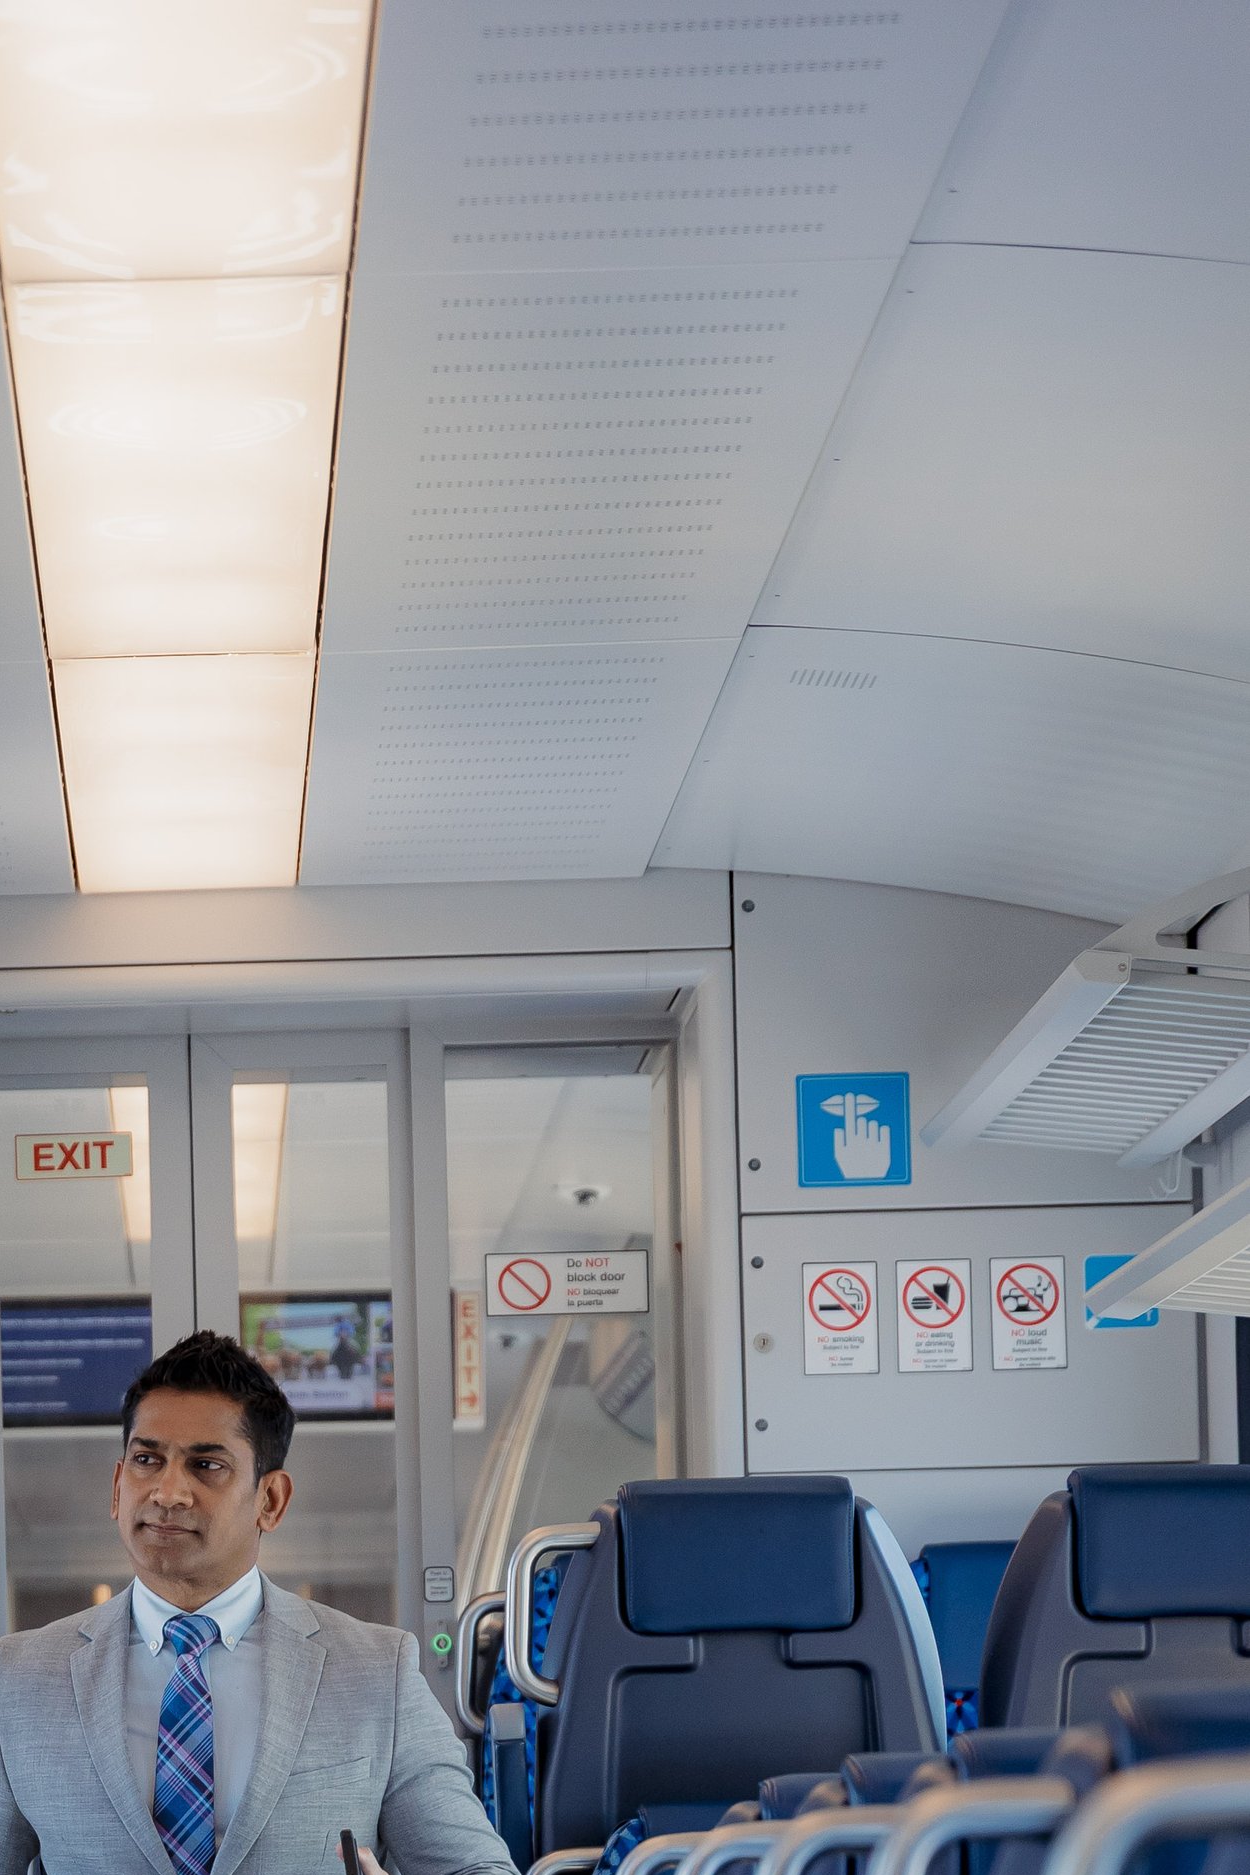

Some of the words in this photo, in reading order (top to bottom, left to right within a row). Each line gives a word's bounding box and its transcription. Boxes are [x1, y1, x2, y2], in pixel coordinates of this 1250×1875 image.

[33, 1140, 115, 1171] EXIT
[566, 1258, 582, 1268] Do
[585, 1257, 610, 1267] NOT
[567, 1272, 597, 1282] block
[600, 1271, 626, 1281] door
[567, 1288, 580, 1296] NO
[583, 1288, 620, 1296] bloquear
[577, 1299, 603, 1307] puerta
[1011, 1329, 1025, 1337] NO
[1027, 1328, 1047, 1336] loud
[817, 1335, 829, 1343] NO
[832, 1335, 865, 1343] smoking
